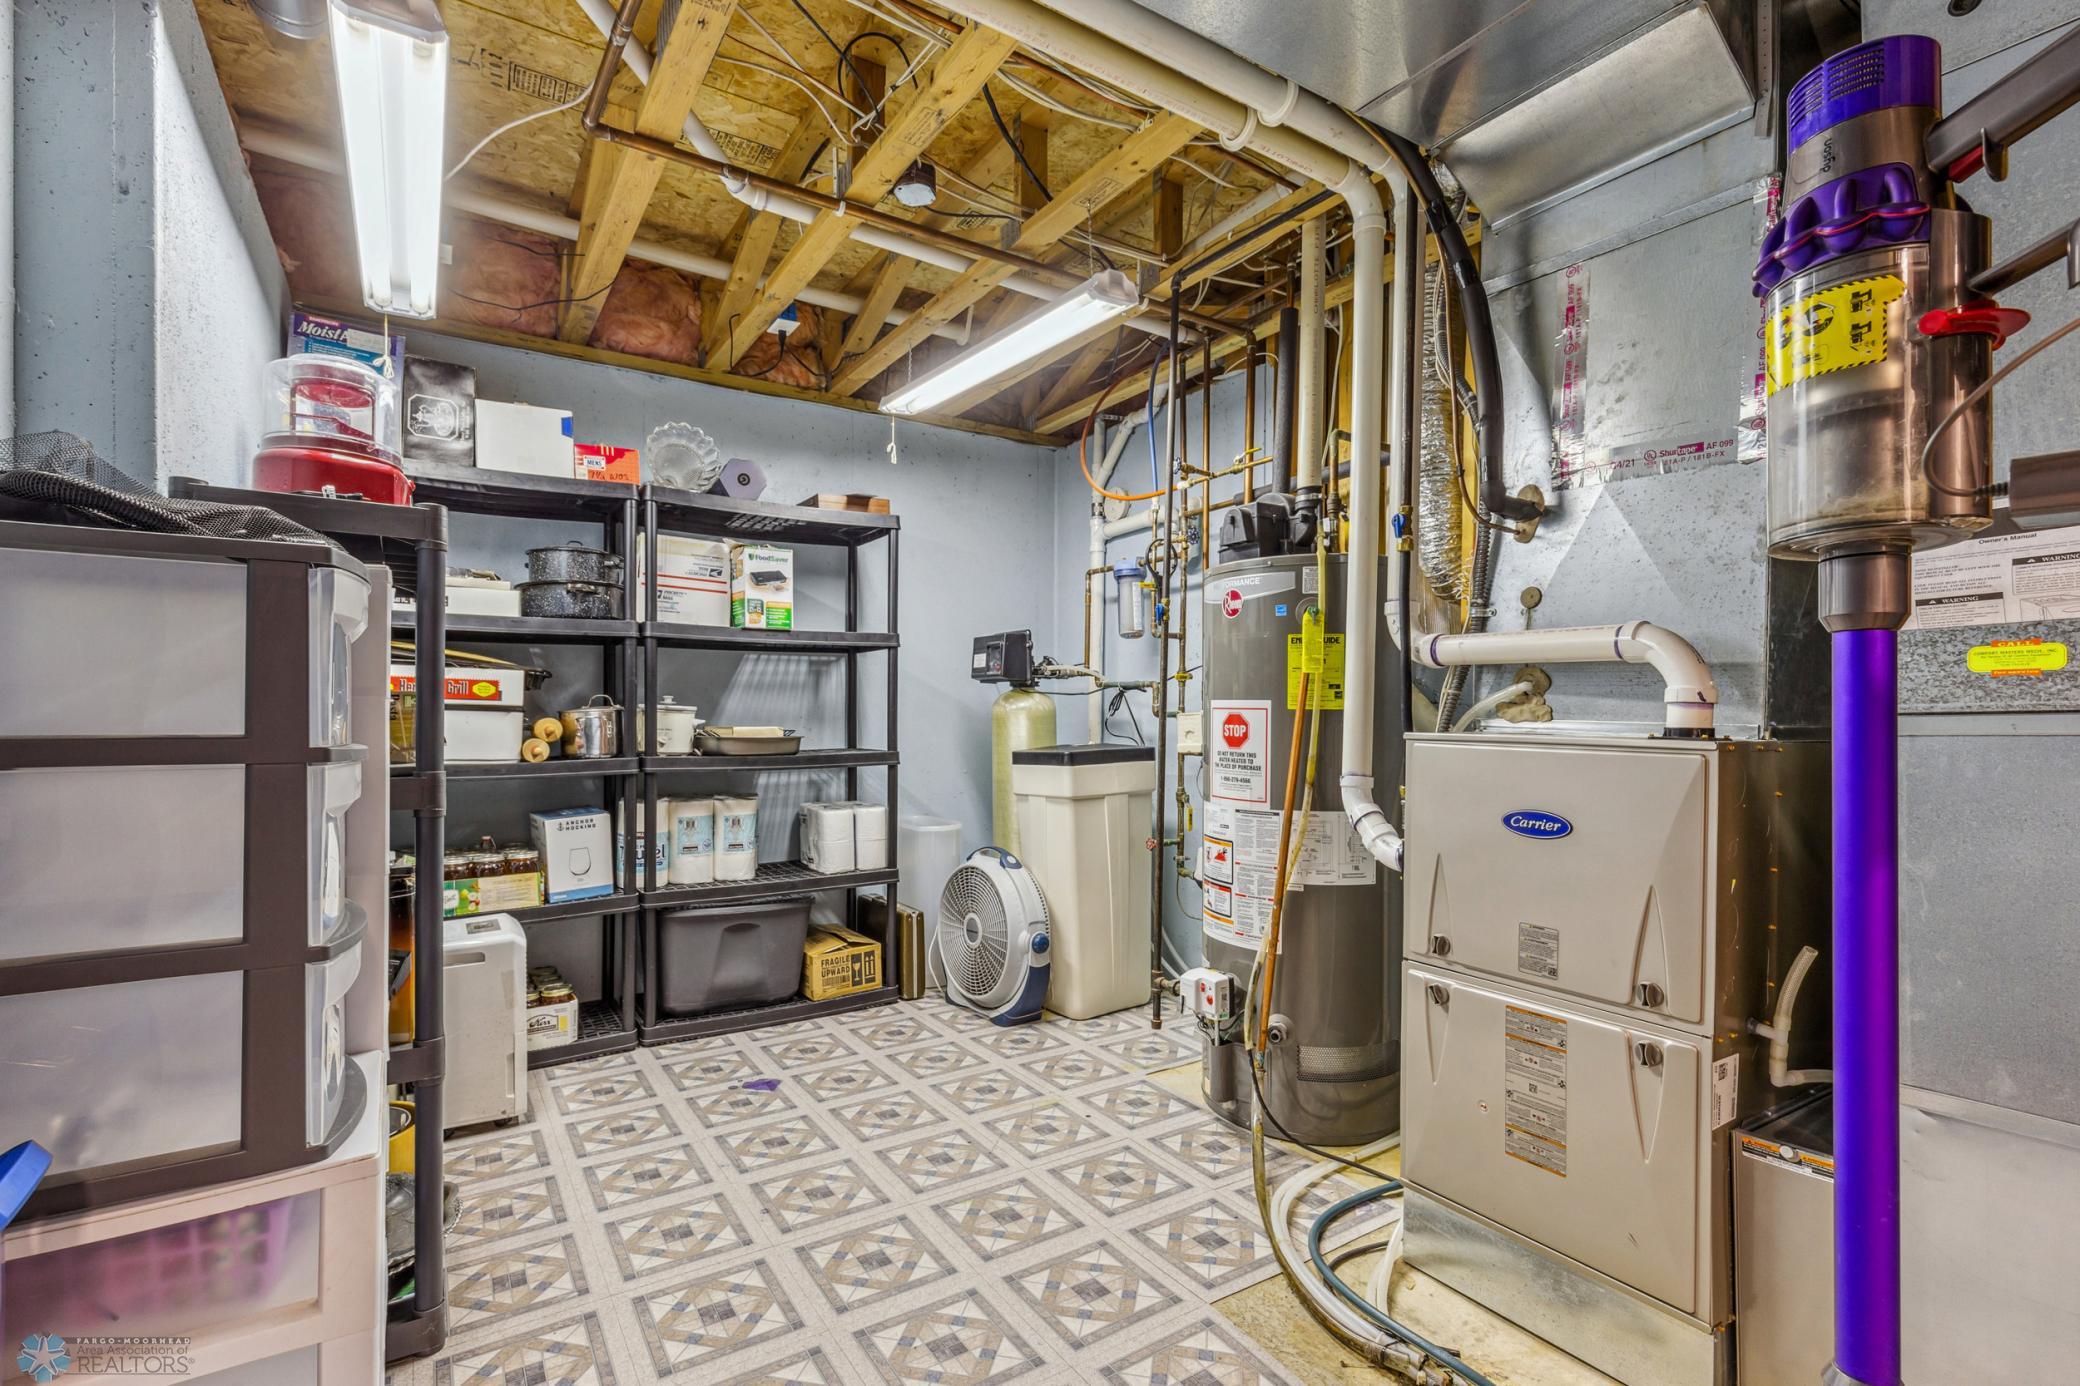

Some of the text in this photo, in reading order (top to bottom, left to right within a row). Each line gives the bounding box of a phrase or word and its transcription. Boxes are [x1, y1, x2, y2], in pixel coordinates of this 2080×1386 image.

[1820, 138, 1835, 172] dyson
[297, 321, 348, 341] MoistA
[1706, 442, 1717, 450] AF
[1720, 439, 1734, 448] 099
[1979, 533, 2037, 545] Owner's Manual
[755, 554, 788, 563] FoodSaver
[1942, 596, 1979, 604] WARNING
[447, 680, 469, 695] Grill
[1223, 724, 1247, 737] STOP
[566, 818, 594, 826] ANCHOR
[1510, 815, 1562, 832] Carrier
[821, 954, 850, 968] FRAGILE
[821, 966, 850, 978] UPWARD
